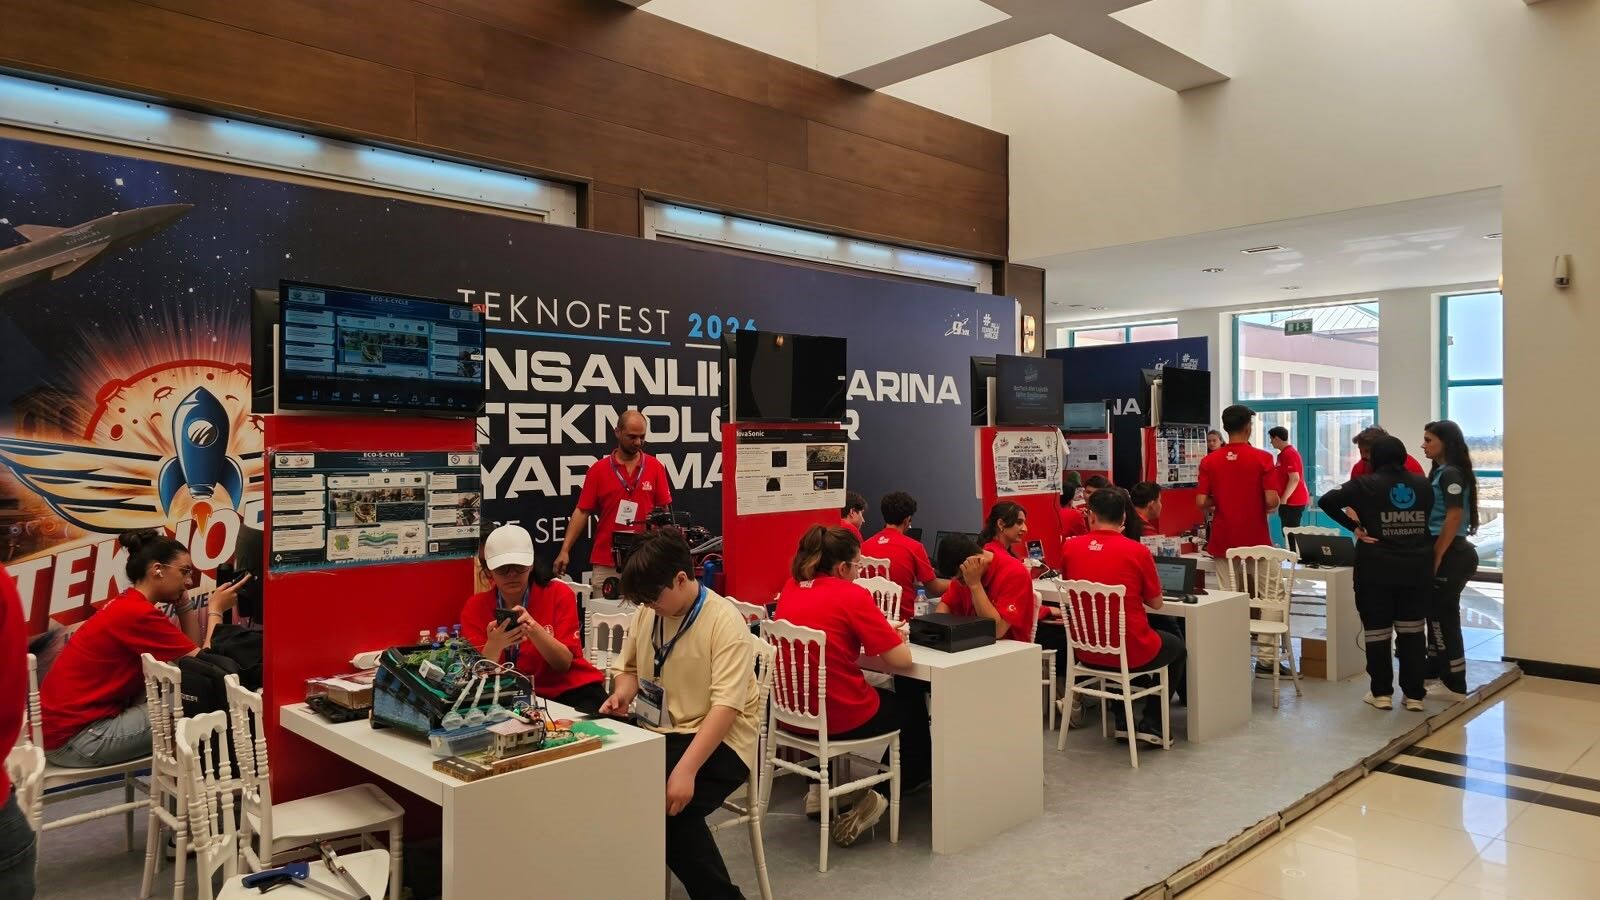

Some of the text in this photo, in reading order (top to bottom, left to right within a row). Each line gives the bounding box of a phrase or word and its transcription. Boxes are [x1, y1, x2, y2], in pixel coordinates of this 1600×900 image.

[457, 288, 670, 335] TEKNOFEST
[484, 347, 962, 405] NSANLI ARINA
[1380, 510, 1425, 523] UMKE
